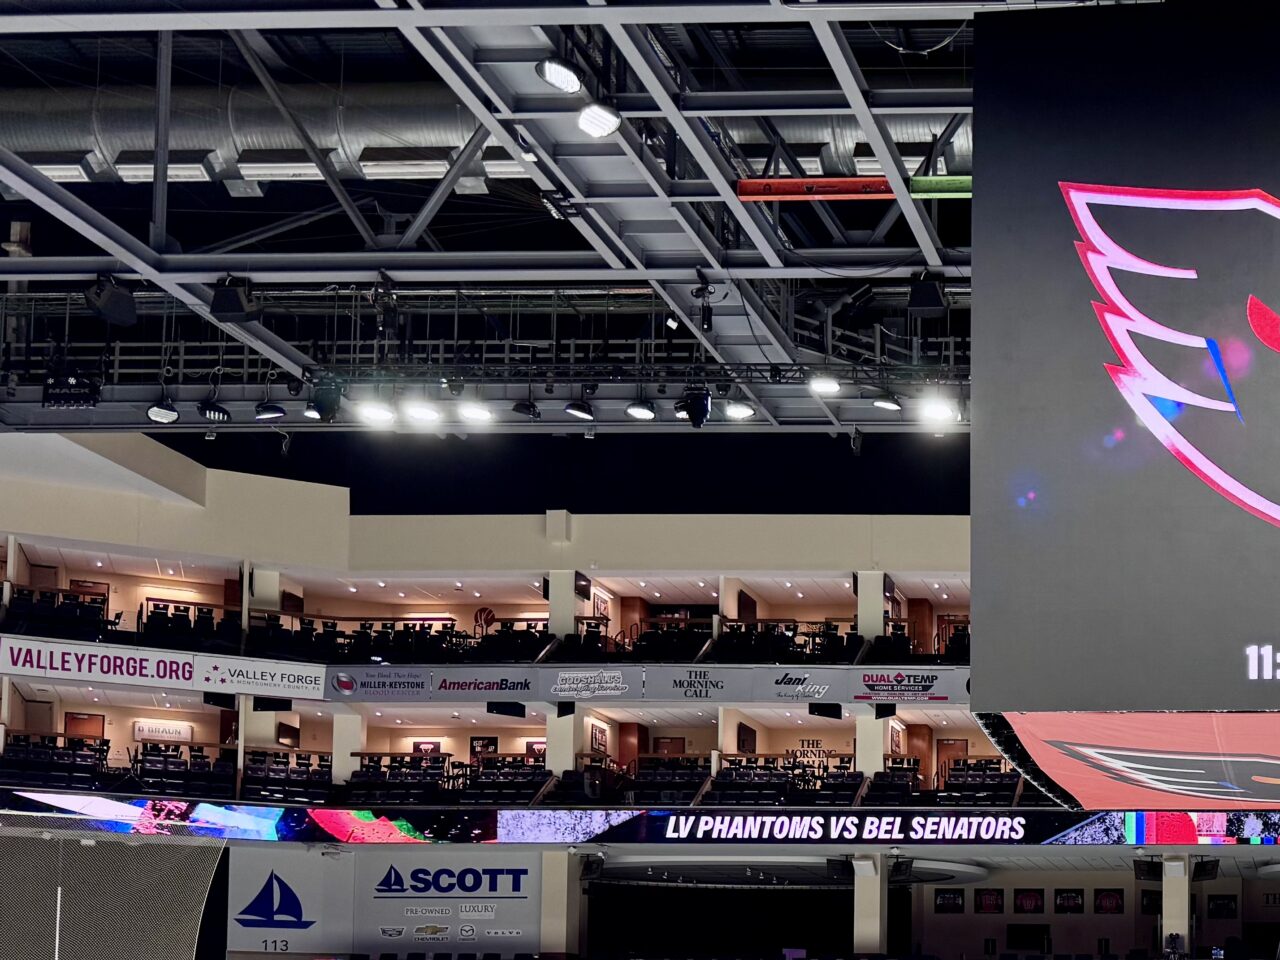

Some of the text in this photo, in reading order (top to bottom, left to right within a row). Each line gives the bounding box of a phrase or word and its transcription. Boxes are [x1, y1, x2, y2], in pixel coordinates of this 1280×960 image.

[9, 646, 193, 681] VALLEYFORGE.ORG
[228, 668, 321, 686] VALLEY FORGE
[687, 670, 710, 680] THE
[774, 673, 810, 686] Jani
[862, 673, 939, 684] DUAL TEMP
[236, 680, 281, 688] MONTGOMERY
[360, 680, 425, 689] MILLER-KEYSTONE
[438, 678, 531, 691] AmericanBank
[672, 679, 724, 690] MORNING
[684, 689, 712, 699] CALL
[795, 683, 830, 698] king
[799, 739, 823, 749] THE
[665, 816, 1026, 840] LV PHANTOMS VS BEL SENATORS
[410, 867, 529, 893] SCOTT
[460, 904, 496, 913] LUXURY
[262, 940, 289, 952] 113
